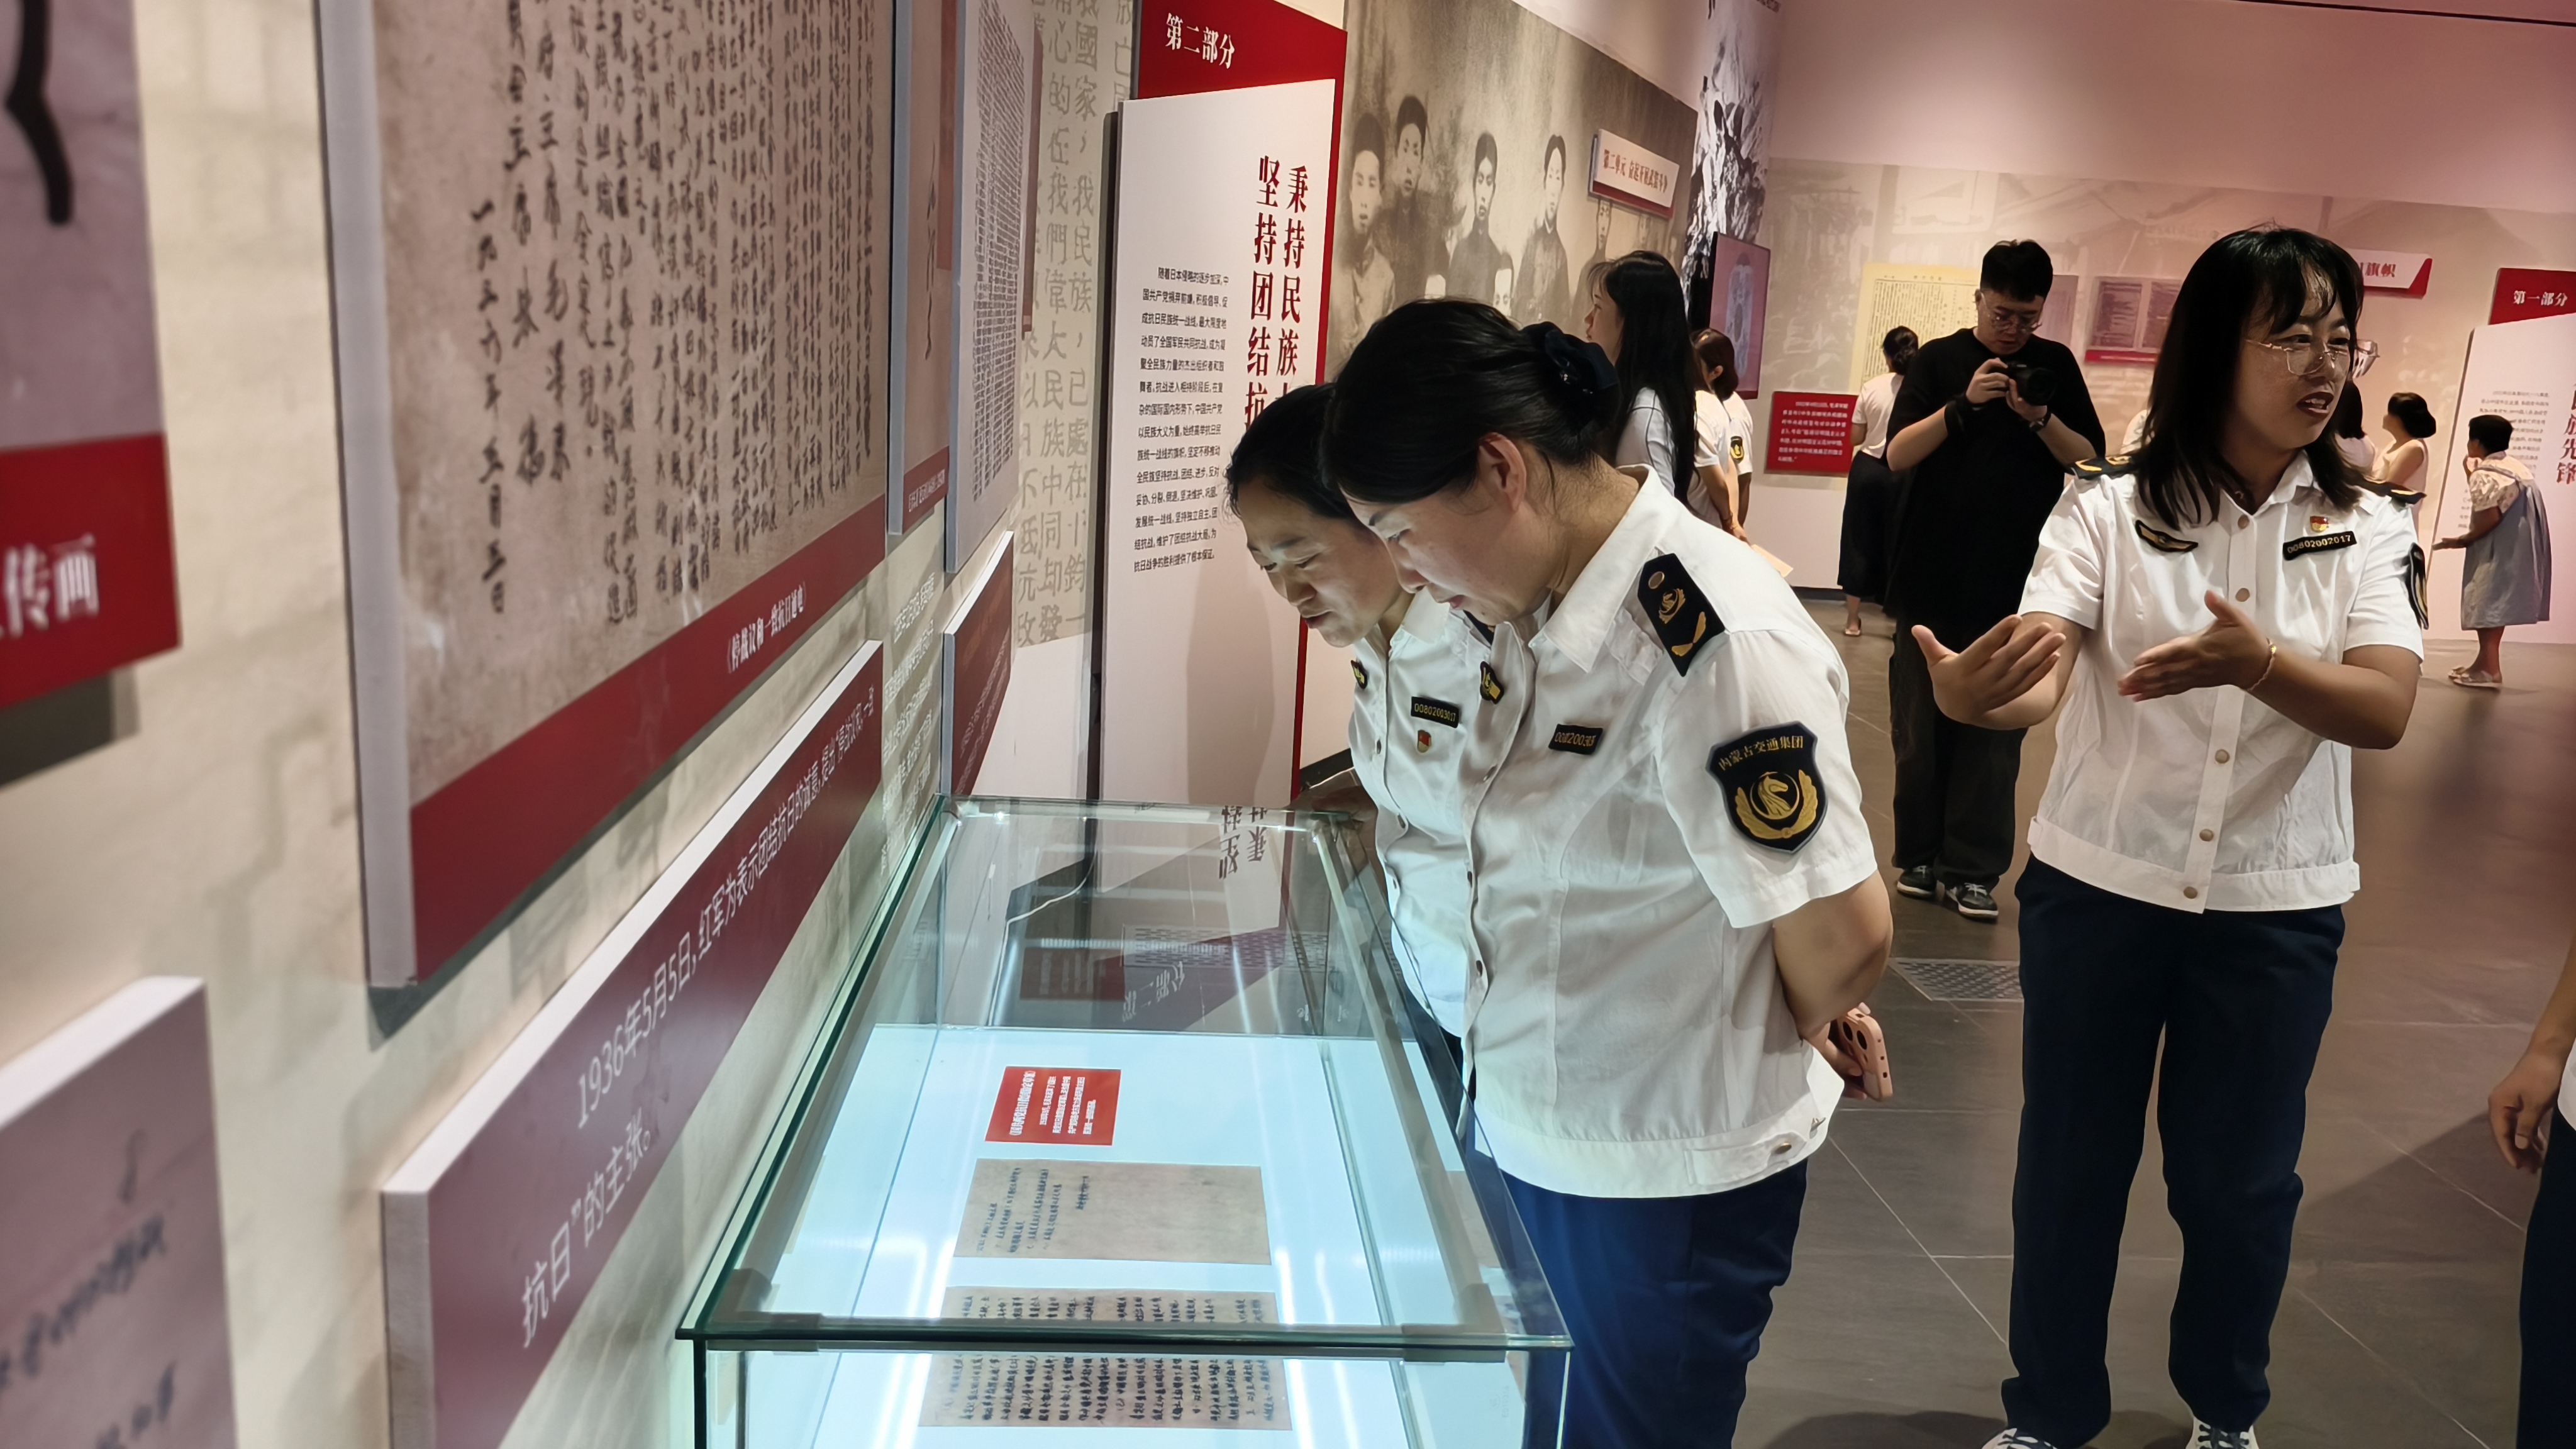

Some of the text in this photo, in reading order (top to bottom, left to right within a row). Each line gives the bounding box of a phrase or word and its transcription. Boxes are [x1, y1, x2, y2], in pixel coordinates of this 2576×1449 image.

[1165, 13, 1235, 69] 第二部分
[2360, 262, 2396, 277] 旗帜
[2512, 290, 2568, 307] 第一部分
[1718, 735, 1803, 770] 内蒙古交通集团
